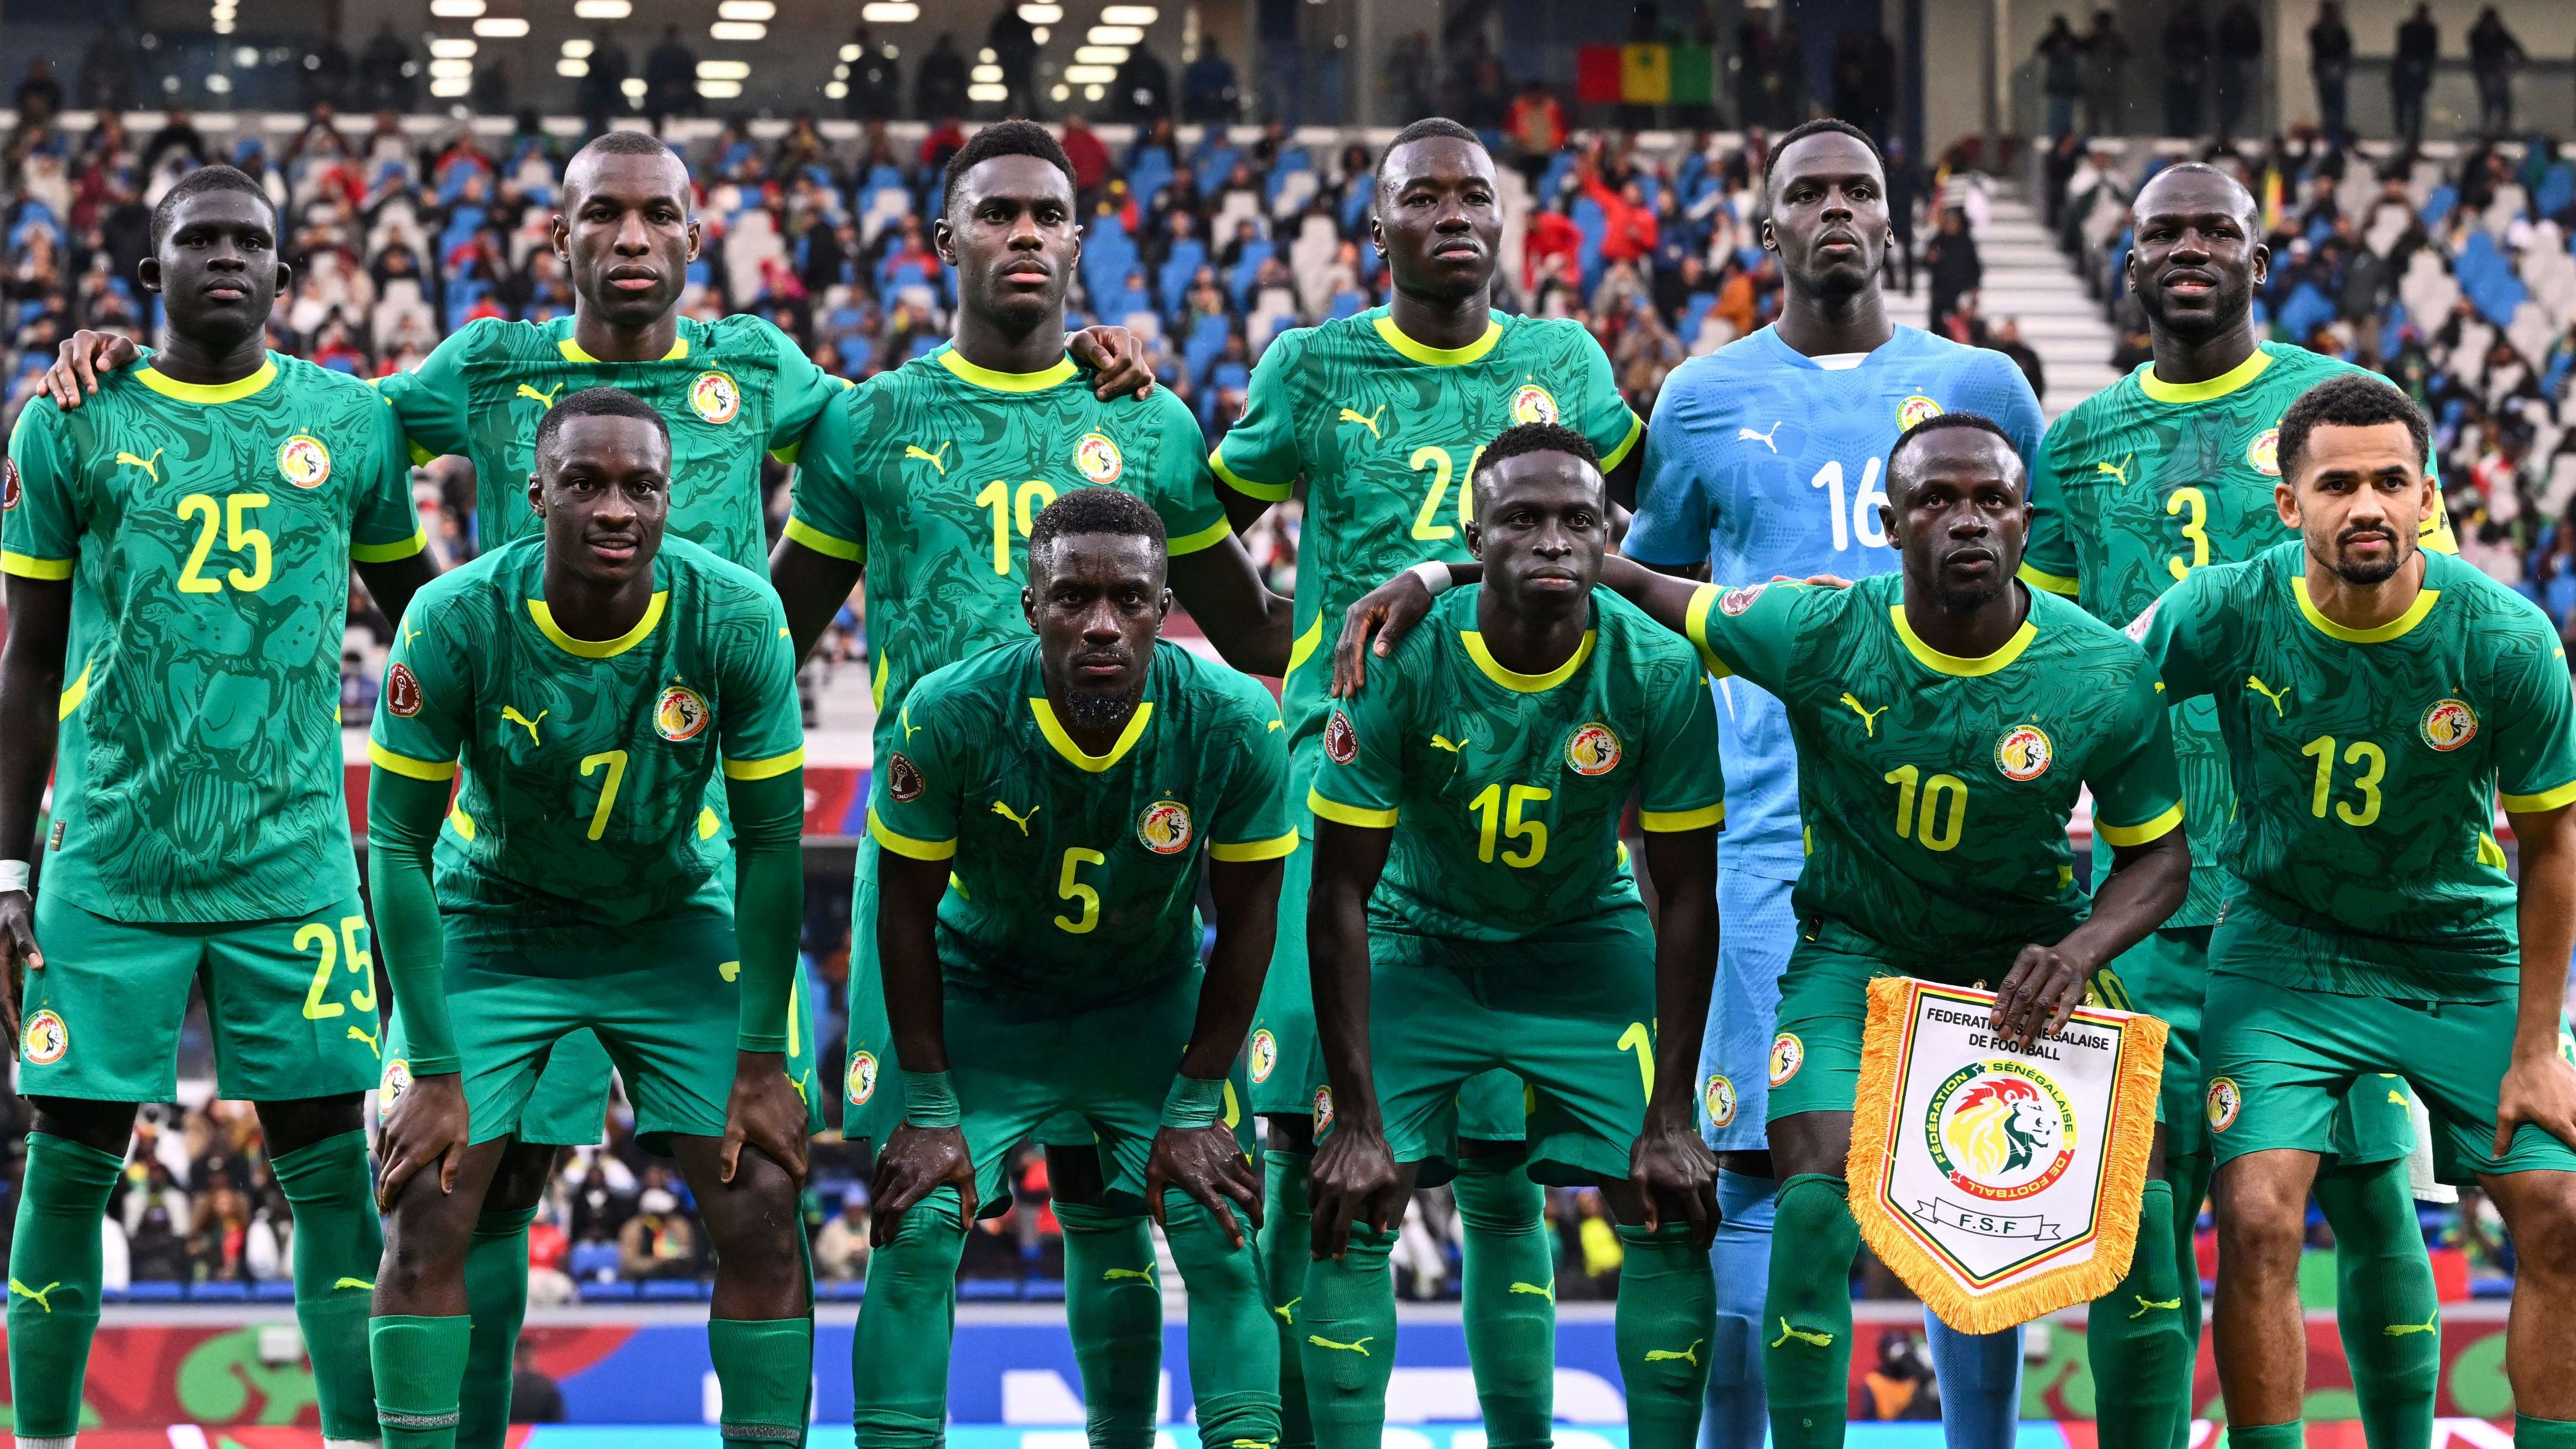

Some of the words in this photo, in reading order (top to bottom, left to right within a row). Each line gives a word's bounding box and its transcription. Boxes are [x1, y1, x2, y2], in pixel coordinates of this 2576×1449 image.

[176, 493, 272, 593] 25
[1811, 456, 1892, 552] 16
[2167, 487, 2209, 584] 3
[580, 749, 628, 841] 7
[1885, 765, 1967, 852] 10
[2302, 735, 2386, 827] 13
[1469, 783, 1552, 868] 15
[1054, 847, 1104, 933] 5
[293, 915, 376, 1019] 25
[1617, 1018, 1658, 1107] 1
[1927, 1007, 2001, 1031] FEDERATI
[2014, 1023, 2109, 1051] SEGALAISE
[1969, 1033, 1988, 1048] DE
[1928, 1071, 1969, 1164] FÉDÉRATION
[1993, 1062, 2074, 1133] SÉNÉGALAISE
[1967, 1176, 2050, 1198] FOOTBALL
[2049, 1156, 2067, 1178] DE
[1959, 1214, 2018, 1234] F.S.F
